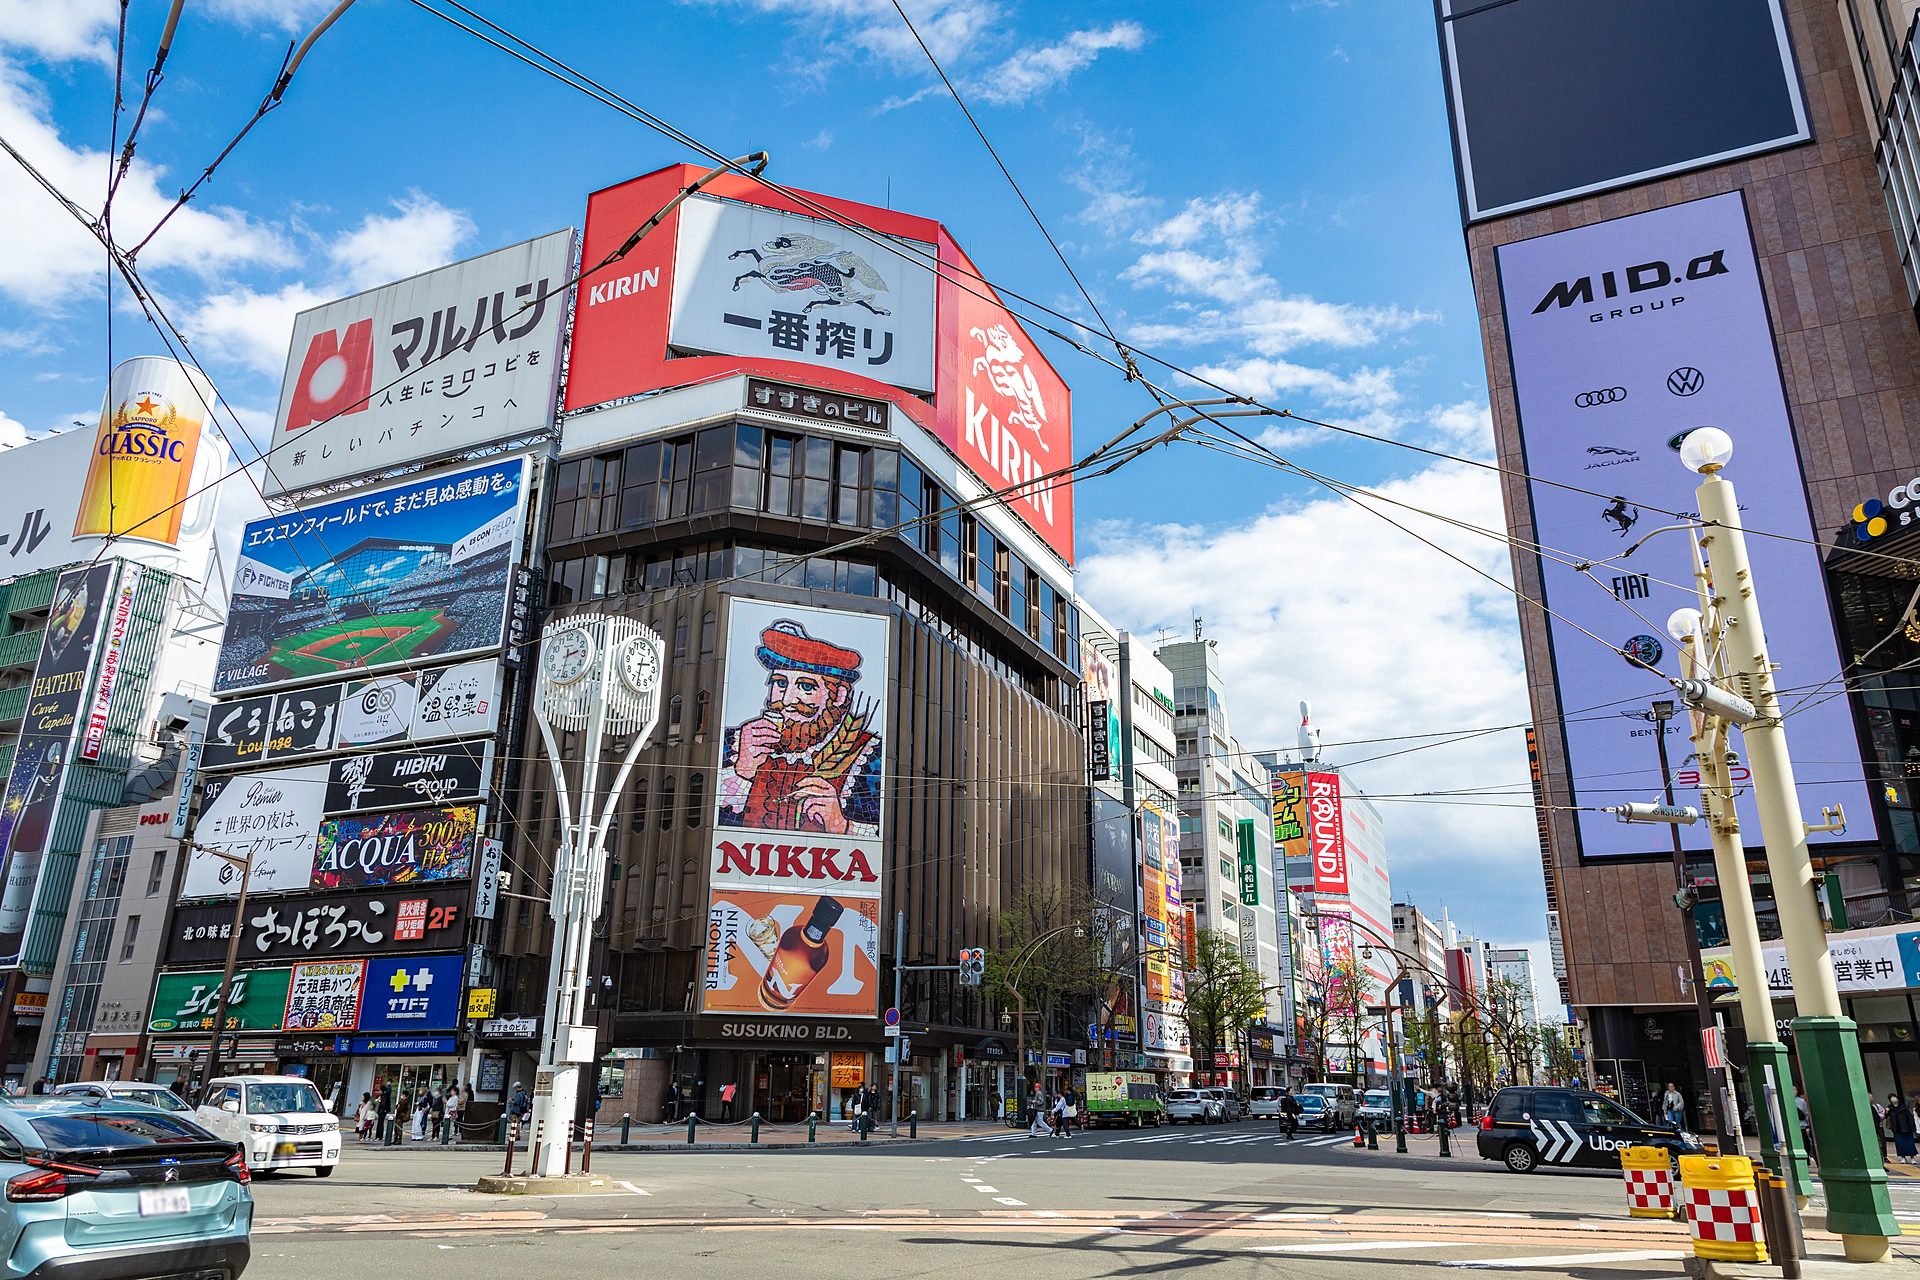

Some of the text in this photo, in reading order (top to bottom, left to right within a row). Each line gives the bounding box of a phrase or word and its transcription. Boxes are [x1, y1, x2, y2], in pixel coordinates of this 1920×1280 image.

[589, 267, 660, 306] KIRIN
[1589, 297, 1685, 323] GROUP
[391, 278, 549, 373] マルハン
[724, 309, 893, 366] 一番搾り
[380, 350, 540, 407] 人生にヨロコビを
[754, 387, 882, 425] すすきのビル
[293, 399, 517, 467] 新しいパチンコへ
[99, 433, 184, 462] CLASSIC
[965, 385, 1053, 527] KIRIN
[1583, 456, 1641, 470] JAGUAR
[248, 473, 513, 547] エスコンフィールドで、まだ見ぬ感動を。
[258, 573, 290, 592] FIGHTERS
[1612, 573, 1650, 601] FIAT
[113, 595, 133, 638] カラオケ
[507, 569, 531, 663] すすきのビル
[32, 670, 85, 698] HATHYR
[227, 663, 270, 680] VILLAGE
[424, 673, 437, 686] 2F
[422, 690, 477, 722] 温野菜
[38, 714, 74, 732] Capella
[217, 698, 317, 746] くろねこ
[237, 736, 292, 755] Lounge
[392, 755, 447, 777] HIBIKI
[1679, 767, 1750, 785] BD
[175, 768, 196, 826] グリーンビル
[205, 782, 221, 799] 9F
[415, 777, 458, 796] Group
[1272, 787, 1299, 804] ーン
[418, 821, 469, 848] 300坪
[1146, 819, 1160, 843] 快活
[1311, 782, 1345, 884] ROUND1
[319, 833, 416, 874] ACQUA
[421, 847, 465, 871] 日本一
[716, 840, 878, 882] NIKKA
[1146, 843, 1160, 860] CLUB
[1243, 863, 1255, 903] 美松ビル
[251, 901, 384, 952] さっぽろっこ
[428, 907, 457, 929] 2F
[706, 910, 723, 990] FRONTIER
[724, 910, 739, 962] NIKKA
[295, 977, 351, 994] 元祖串かつ
[291, 994, 356, 1011] 恵美須商店
[305, 1018, 315, 1027] 1F
[722, 1023, 852, 1040] SUSUKINO BLD.
[376, 1041, 399, 1049] HOKKAIDO
[835, 1055, 843, 1084] スクエア
[1589, 1135, 1632, 1151] Uber
